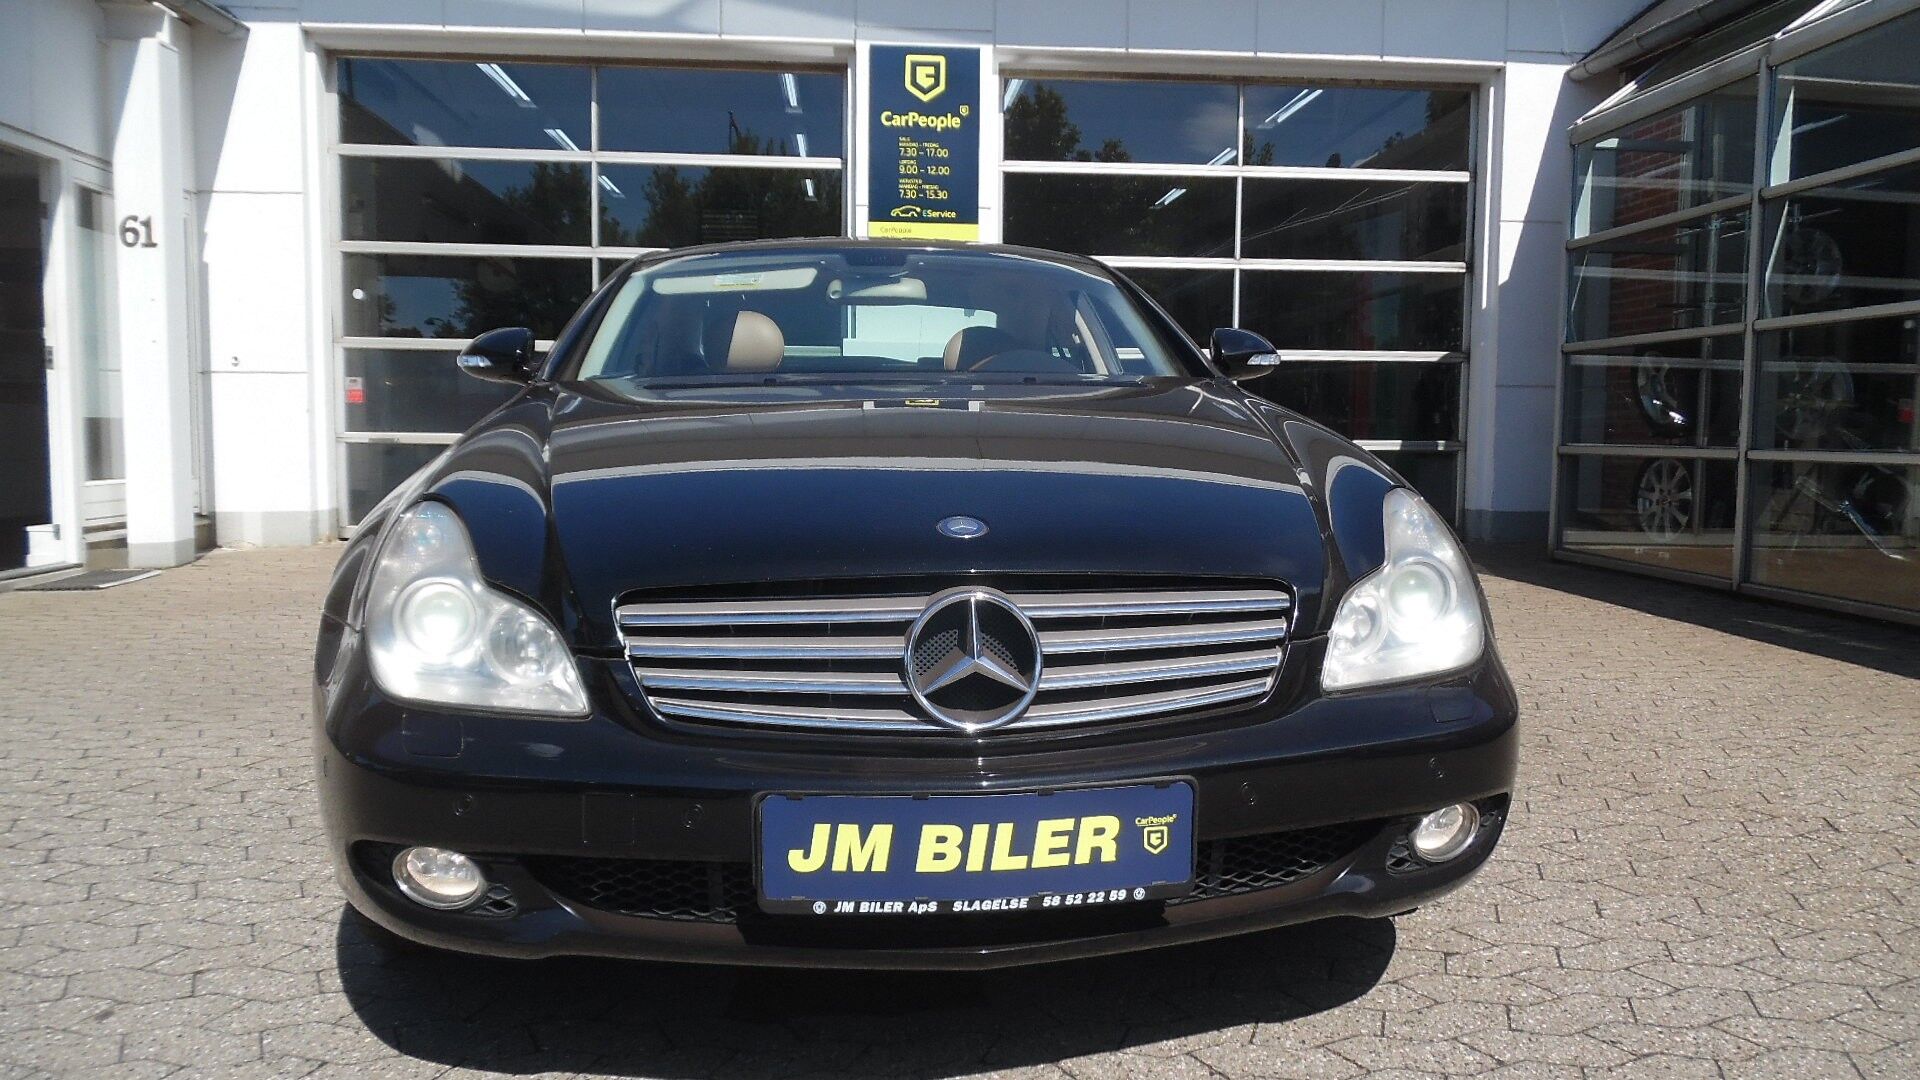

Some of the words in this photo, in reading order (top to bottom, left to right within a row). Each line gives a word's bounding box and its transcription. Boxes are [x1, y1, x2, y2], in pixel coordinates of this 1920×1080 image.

[881, 111, 961, 131] CarPeople
[899, 147, 917, 157] 7.30
[926, 148, 949, 158] 17.00
[899, 165, 918, 174] 9.00
[926, 166, 950, 175] 12.00
[899, 189, 917, 199] 7.30
[926, 190, 948, 199] 15.30
[119, 215, 158, 248] 61
[1135, 815, 1175, 825] CarPeople
[787, 823, 894, 873] JM
[915, 815, 1120, 873] BILER
[834, 901, 855, 913] JM
[859, 901, 904, 913] BILER
[908, 901, 938, 914] ApS
[952, 898, 1030, 912] SLAGELSE
[1042, 896, 1061, 907] 58
[1065, 894, 1083, 905] 52
[1087, 891, 1106, 903] 22
[1109, 889, 1127, 901] 59
